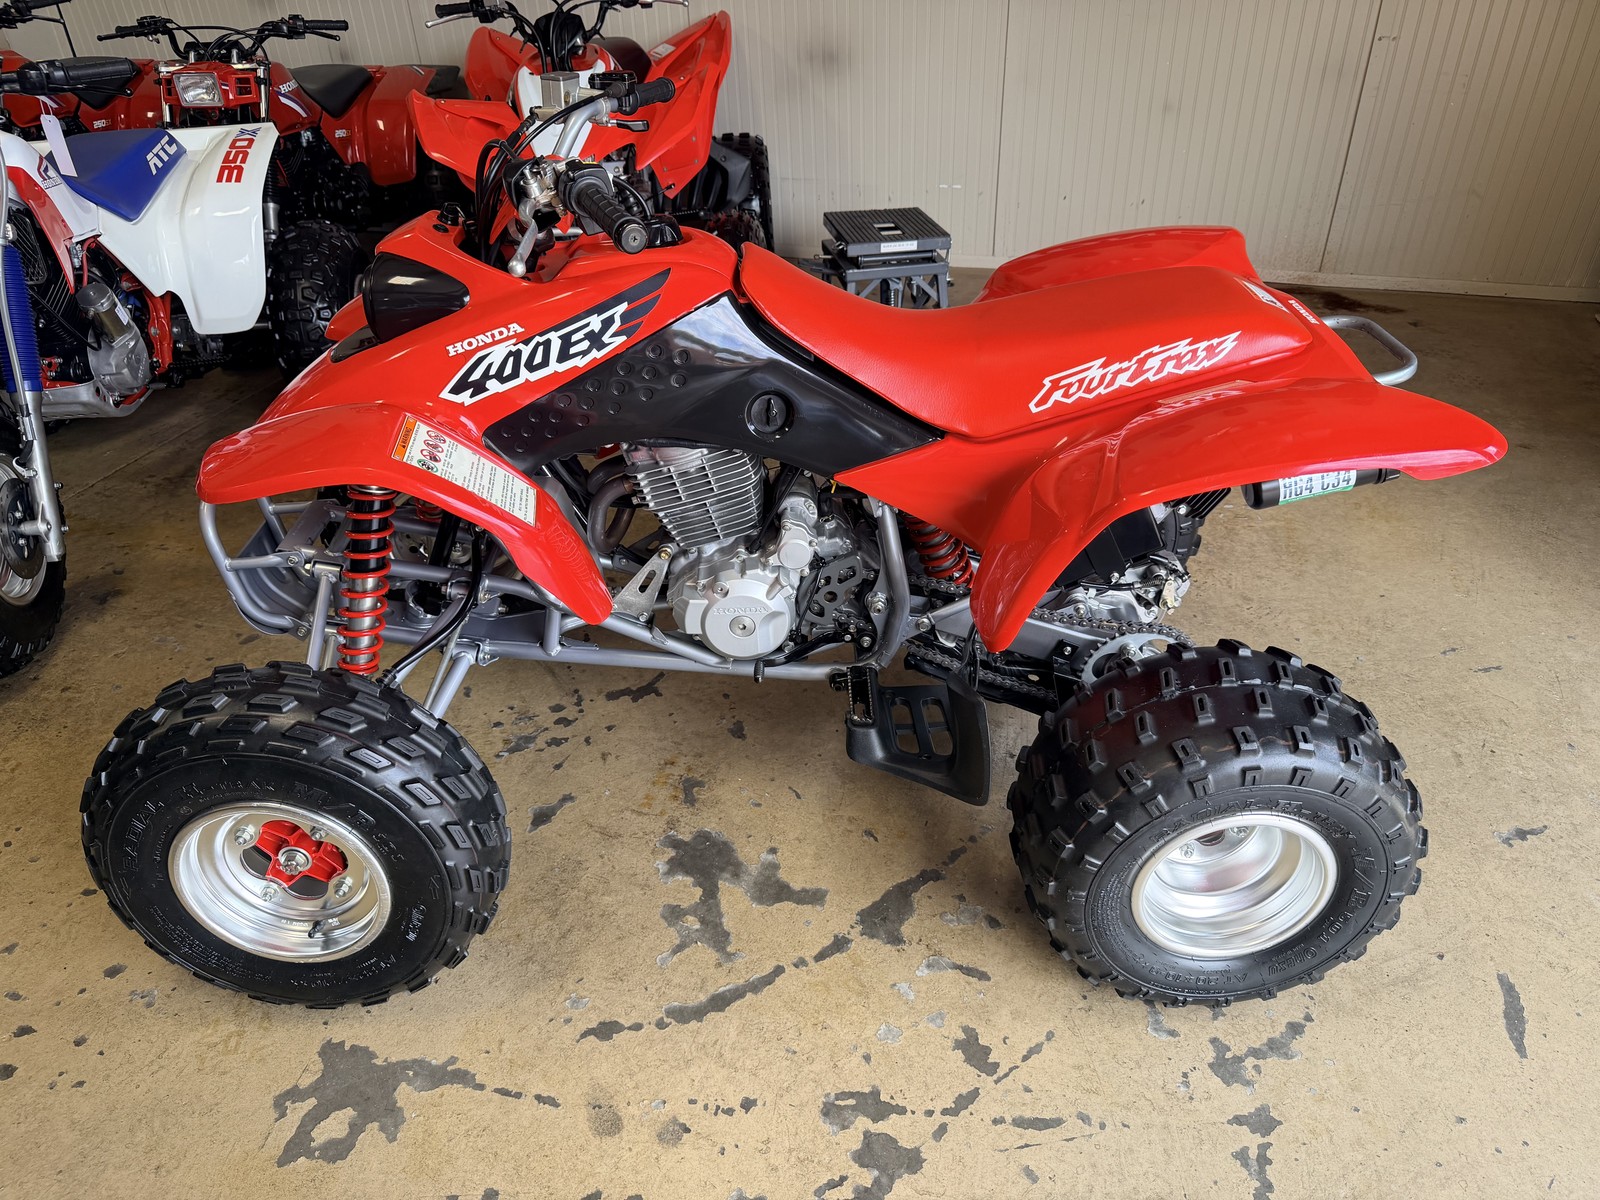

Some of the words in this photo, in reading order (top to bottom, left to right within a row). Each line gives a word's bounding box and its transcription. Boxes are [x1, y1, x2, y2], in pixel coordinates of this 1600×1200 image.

[146, 135, 178, 176] ATC
[216, 127, 261, 183] 350X
[438, 301, 629, 407] 400EX
[446, 322, 525, 357] HONDA
[713, 606, 769, 615] HONDA
